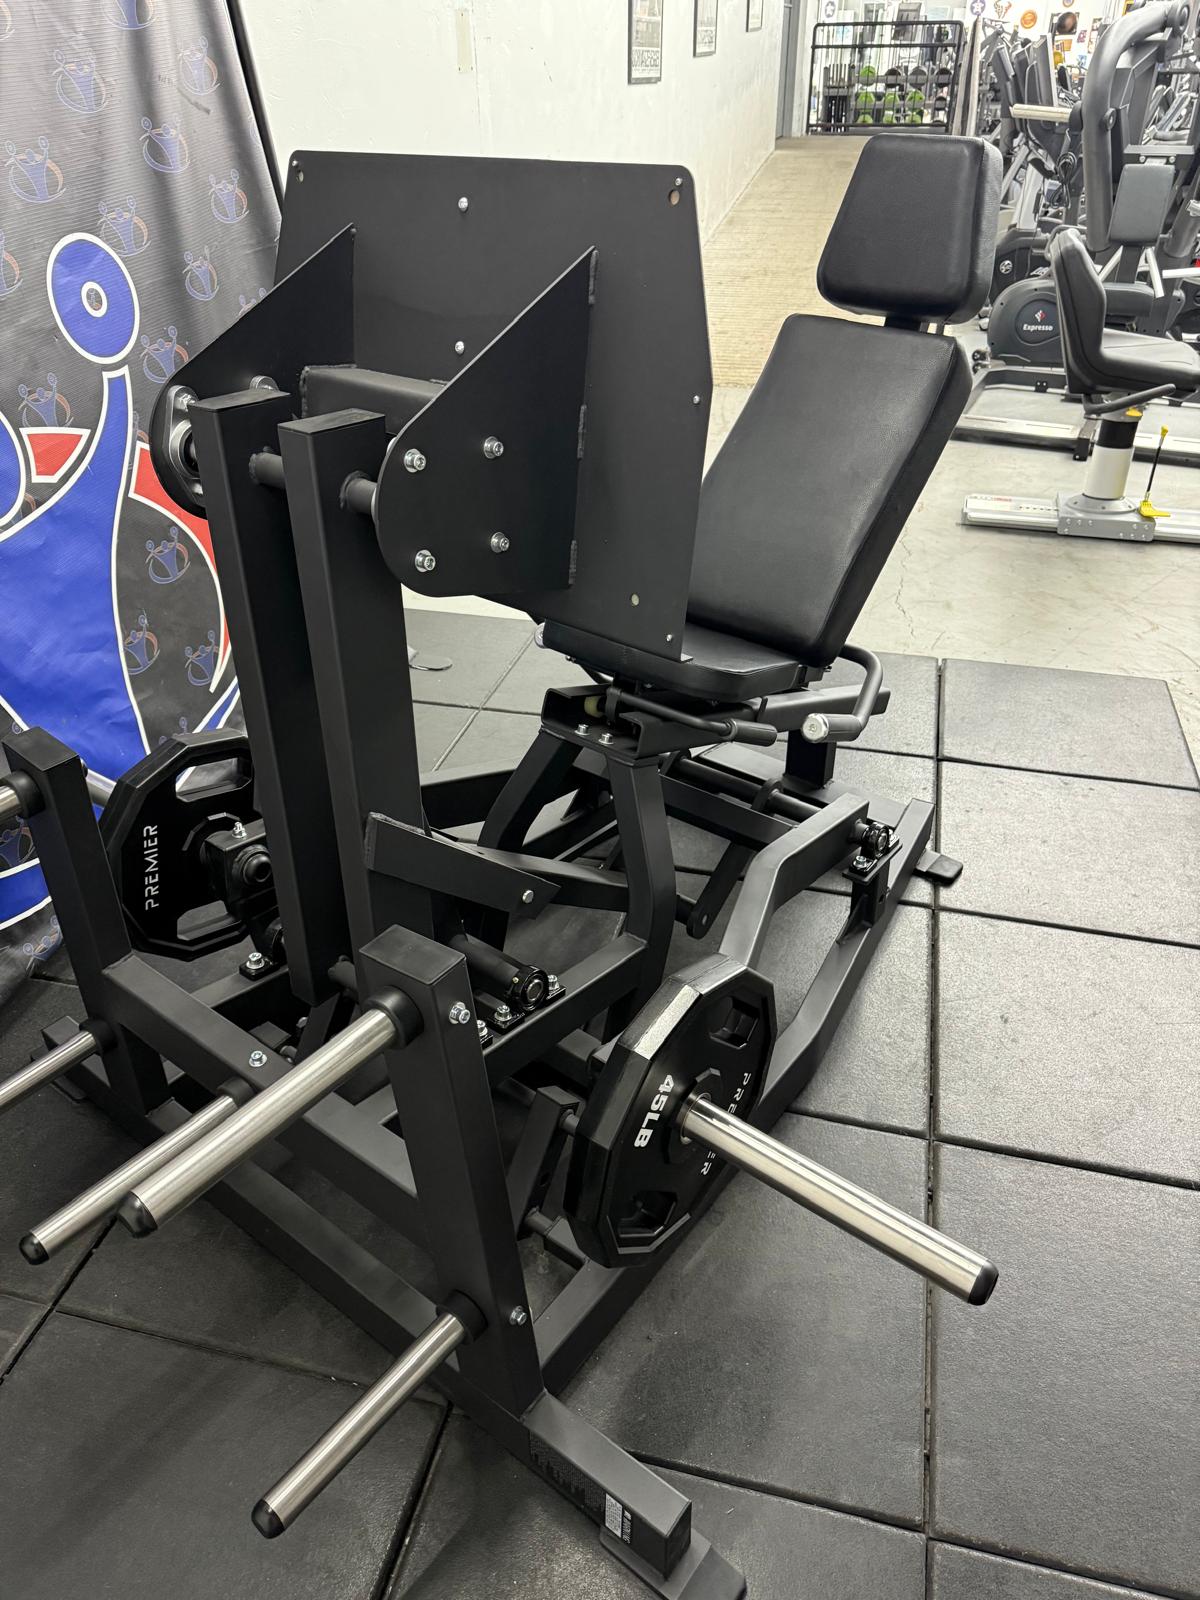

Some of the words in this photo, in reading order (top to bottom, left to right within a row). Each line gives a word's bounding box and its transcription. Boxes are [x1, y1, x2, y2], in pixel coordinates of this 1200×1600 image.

[1023, 324, 1053, 332] Expresso
[143, 824, 159, 910] PREMIER
[633, 1074, 674, 1147] 45LB
